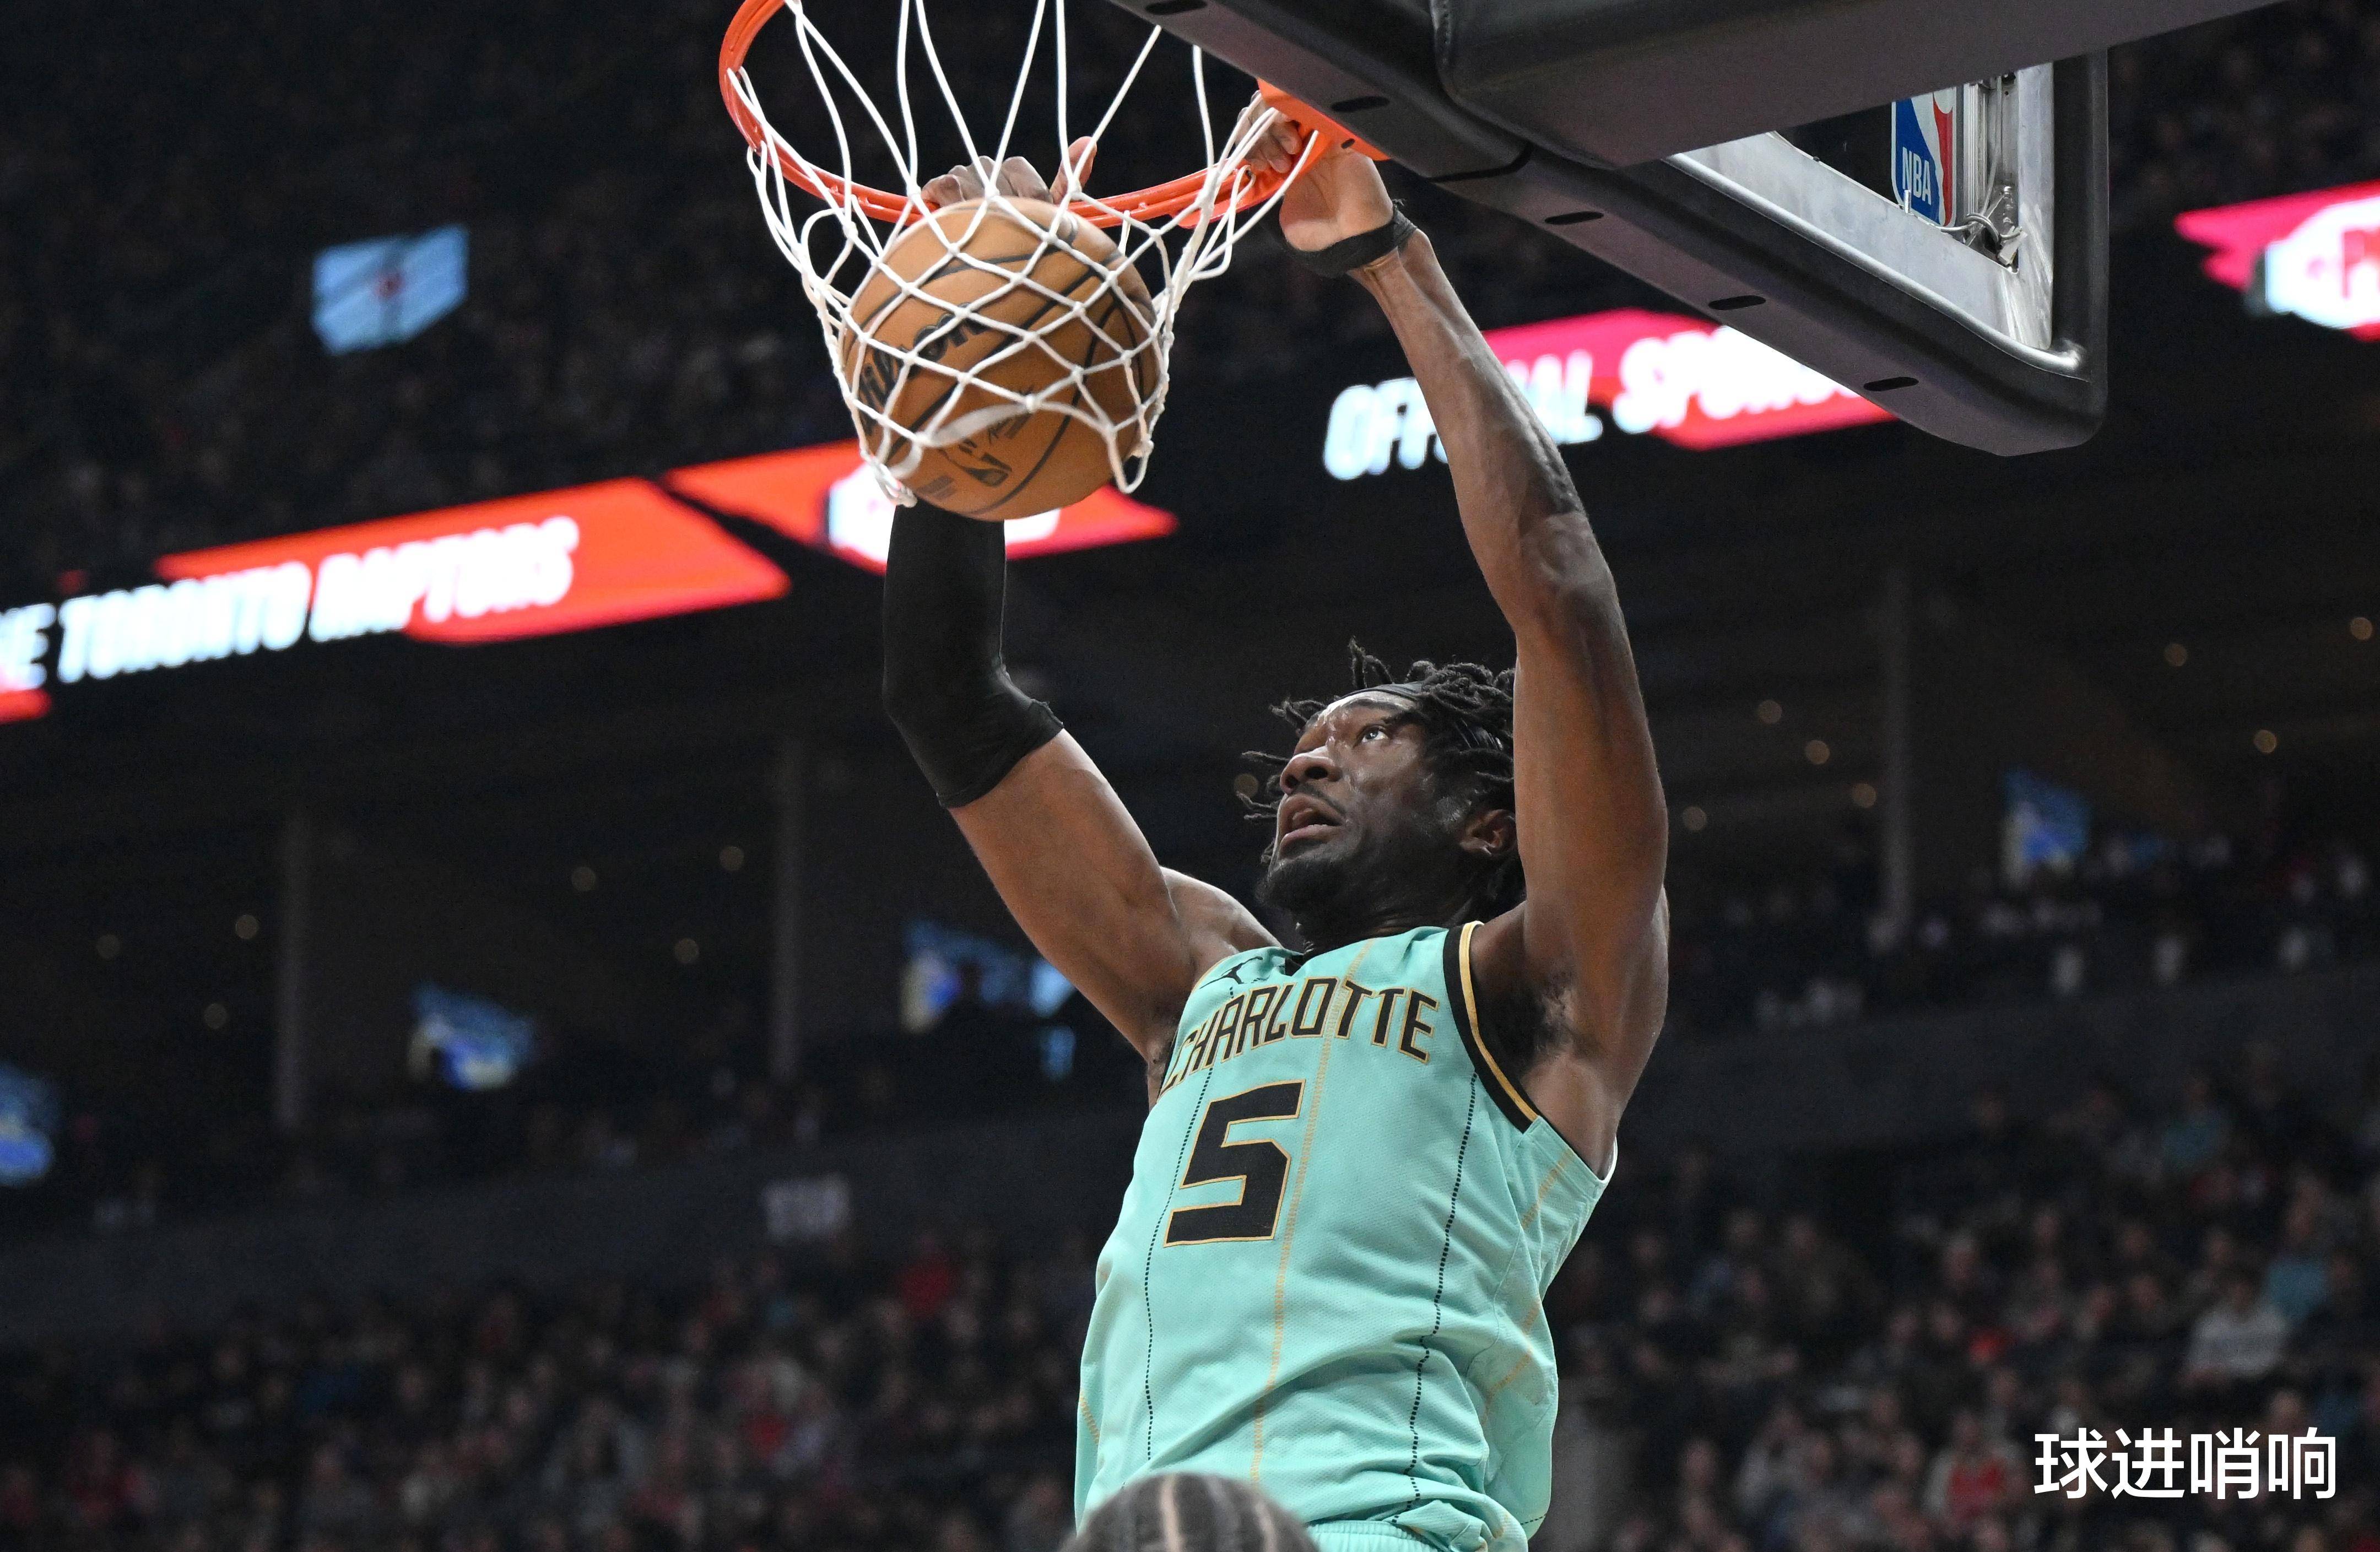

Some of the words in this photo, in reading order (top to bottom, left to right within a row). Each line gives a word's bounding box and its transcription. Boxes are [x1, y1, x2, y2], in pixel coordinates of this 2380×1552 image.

[1901, 146, 1932, 206] NBA
[1323, 348, 1602, 480] OFFAL
[57, 560, 312, 683] TORONTO
[309, 515, 578, 642] RAPTORS
[1157, 976, 1439, 1102] CHARLOTTE
[1162, 1078, 1307, 1248] 5
